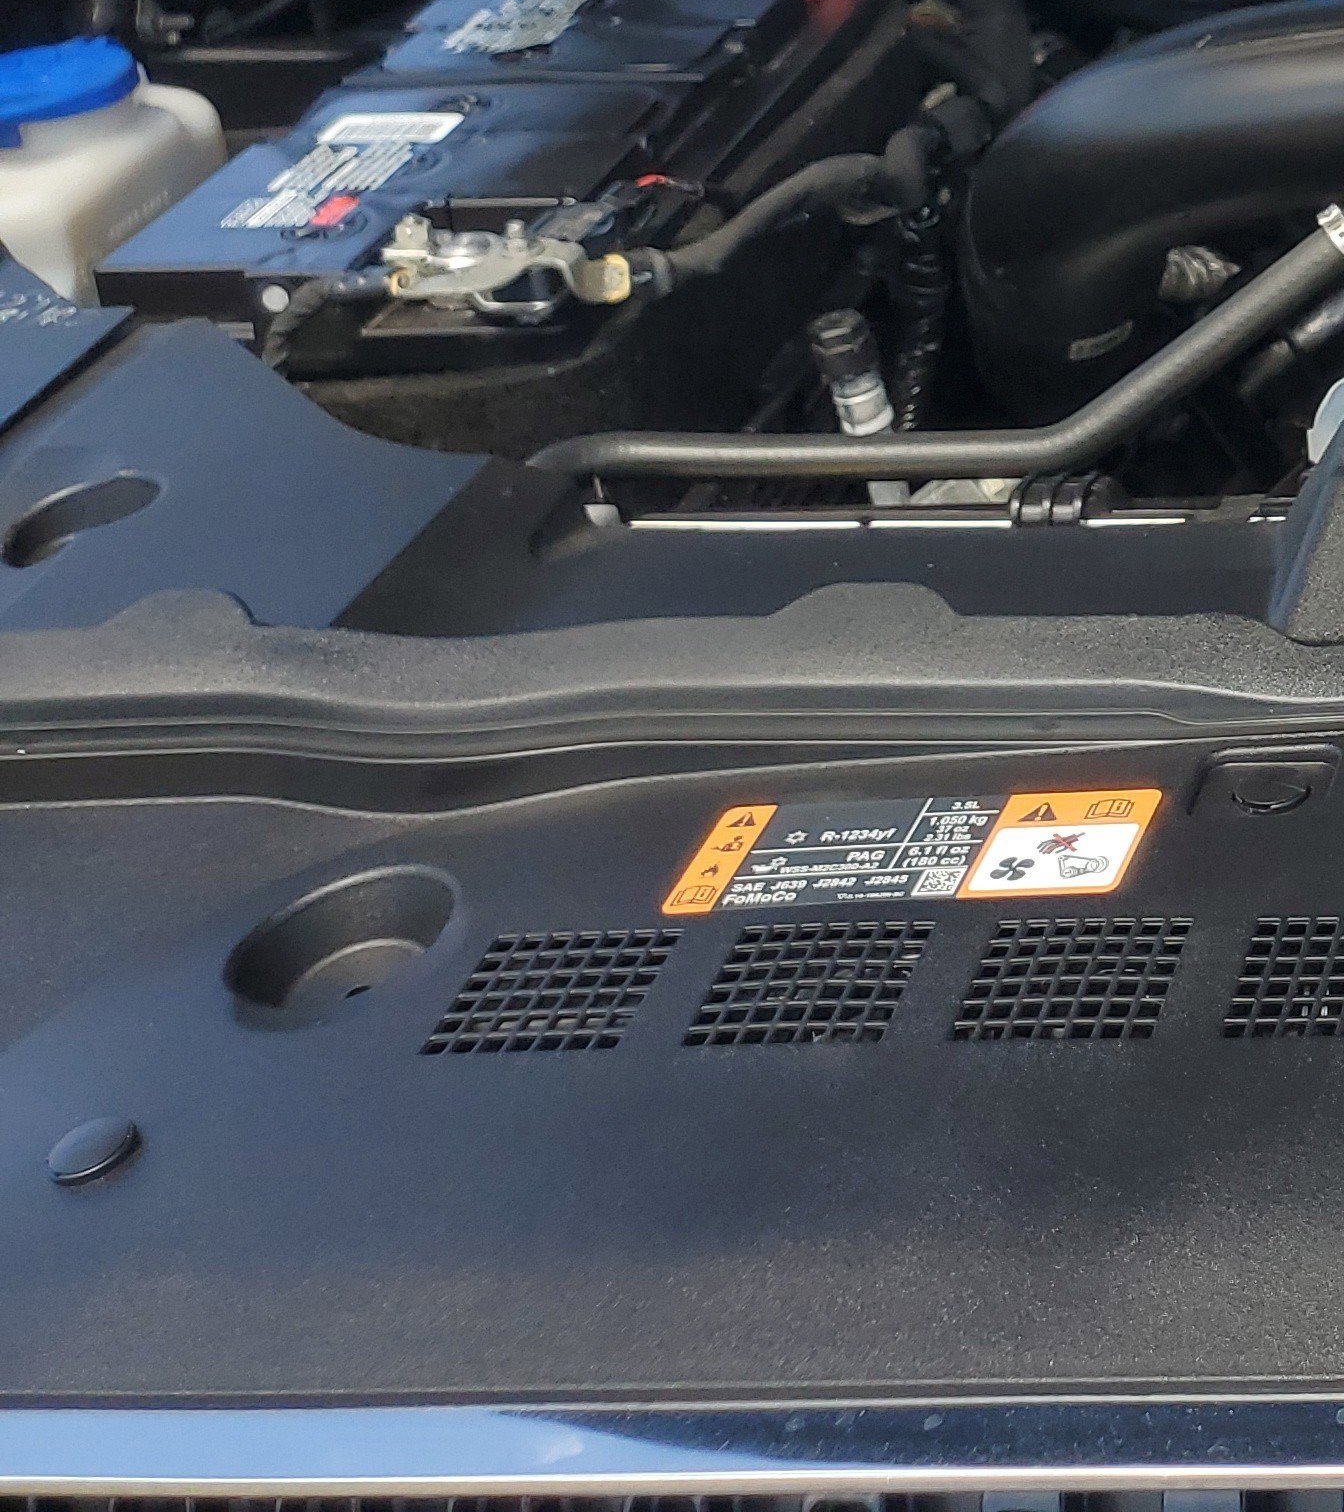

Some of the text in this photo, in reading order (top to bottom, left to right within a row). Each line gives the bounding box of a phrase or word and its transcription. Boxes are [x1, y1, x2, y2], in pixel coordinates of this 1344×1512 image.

[951, 801, 981, 810] 3.5L
[929, 814, 988, 827] 1.050 kg
[820, 828, 897, 842] R-1234yf
[953, 825, 970, 833] oz
[923, 833, 951, 842] 2.31
[847, 850, 885, 861] PAG
[908, 846, 933, 856] 6.1
[950, 846, 971, 854] oz
[902, 854, 967, 868] (180 cc)
[730, 882, 767, 892] SAE
[770, 879, 808, 890] J639
[722, 891, 797, 905] FoMoCo
